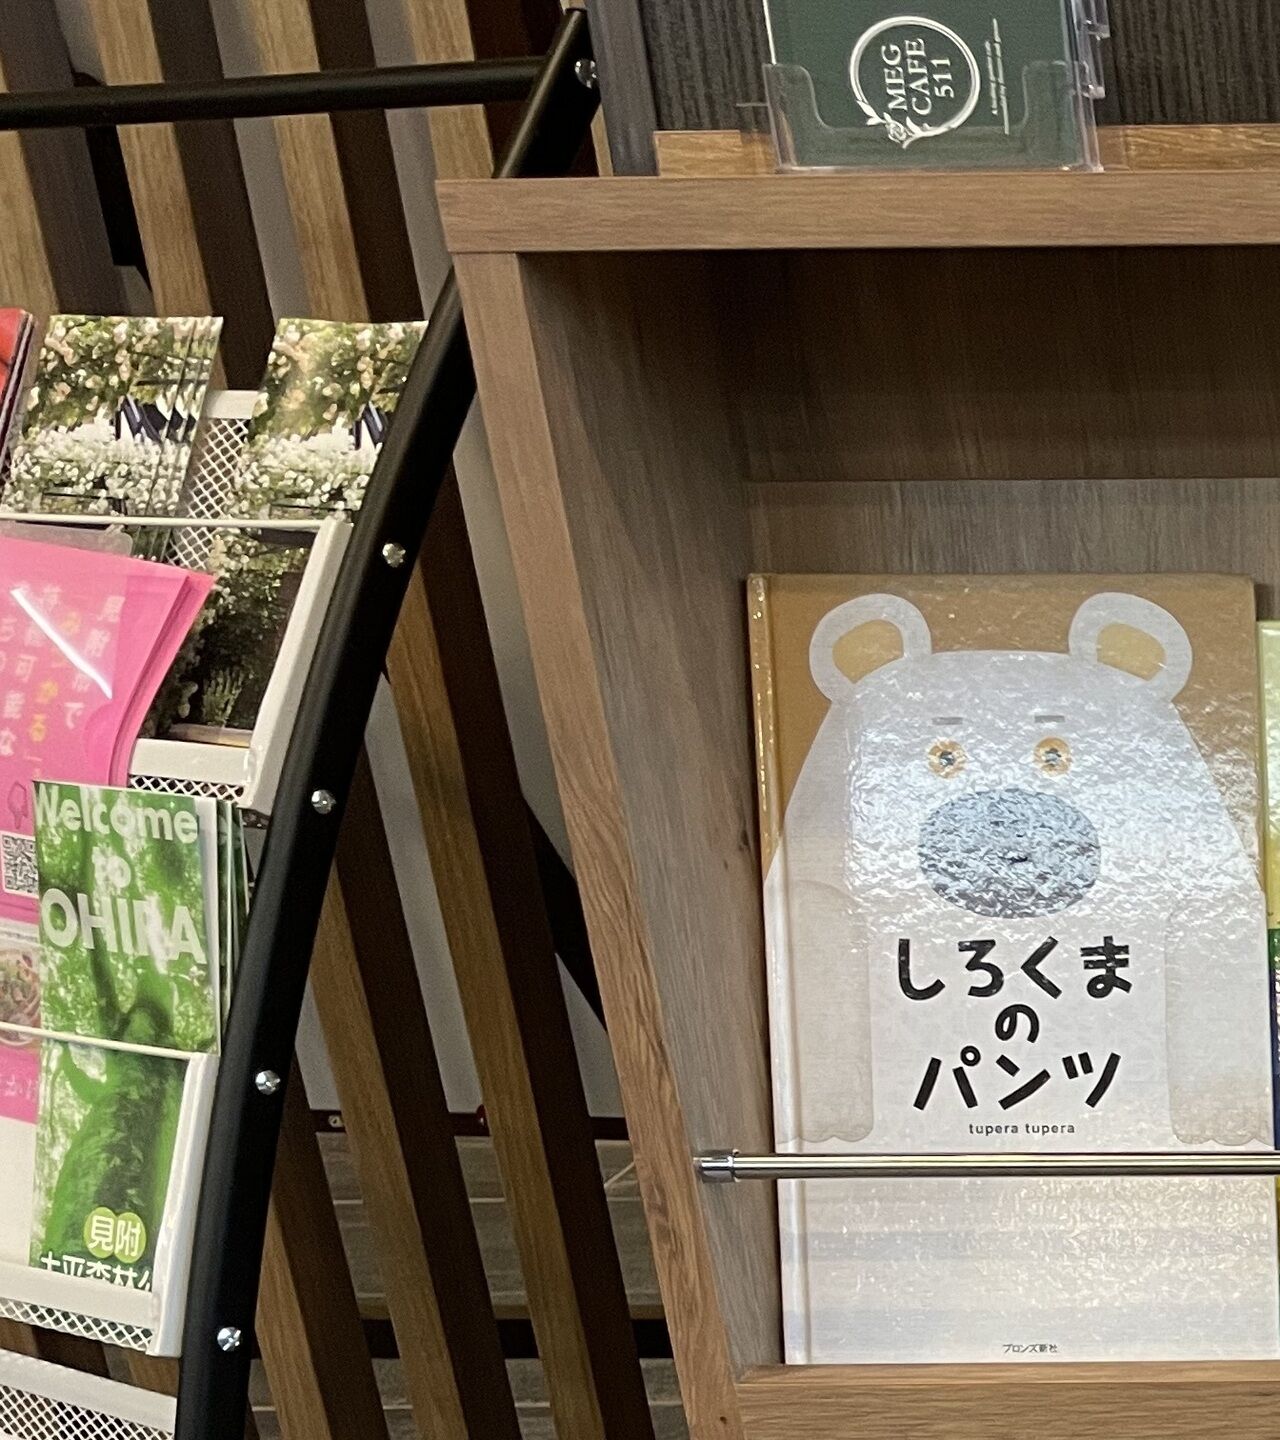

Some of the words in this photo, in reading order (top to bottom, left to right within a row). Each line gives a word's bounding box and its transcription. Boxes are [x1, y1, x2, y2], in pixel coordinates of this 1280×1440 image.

[881, 44, 908, 112] MEG
[905, 38, 932, 116] CAFE
[931, 58, 955, 98] 511
[897, 936, 1132, 1000] しろくま
[994, 1004, 1040, 1043] の
[912, 1046, 1121, 1110] パンツ
[968, 1122, 1019, 1137] tupera
[1025, 1122, 1075, 1137] tupera
[86, 1215, 141, 1258] 見附
